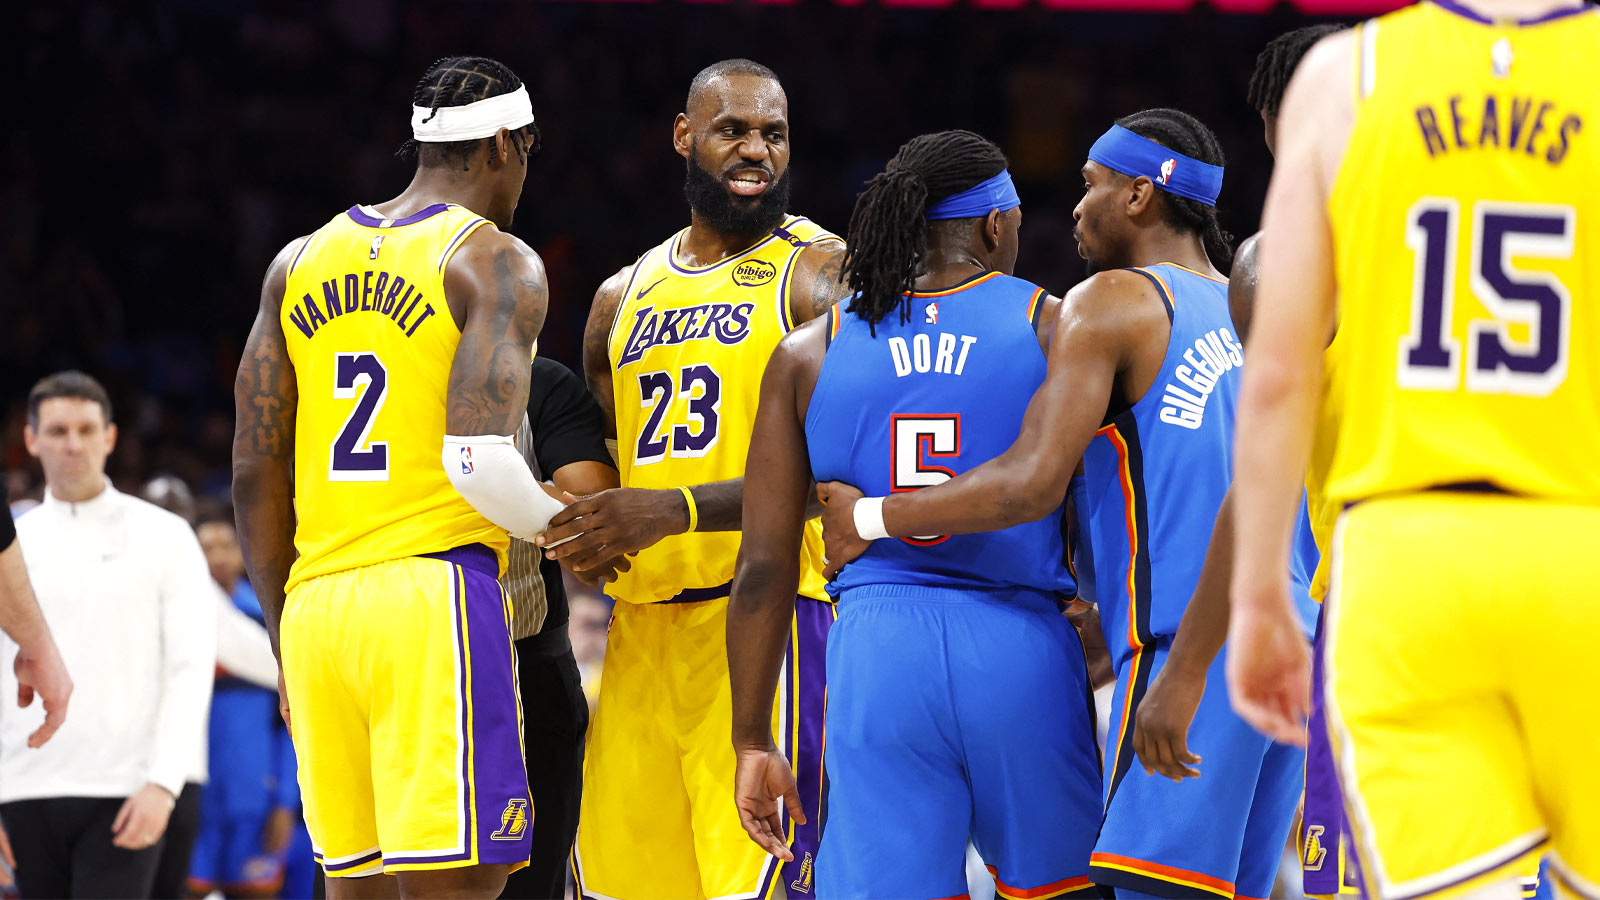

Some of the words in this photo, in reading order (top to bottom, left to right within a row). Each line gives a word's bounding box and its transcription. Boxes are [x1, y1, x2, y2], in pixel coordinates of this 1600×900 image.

[1416, 94, 1582, 167] REAVES
[289, 271, 435, 339] VANDERBILT
[737, 265, 773, 279] bibigo
[1397, 196, 1576, 397] 15
[617, 303, 756, 372] LAKERS
[888, 332, 977, 377] DORT
[328, 351, 389, 482] 2
[633, 362, 722, 466] 23
